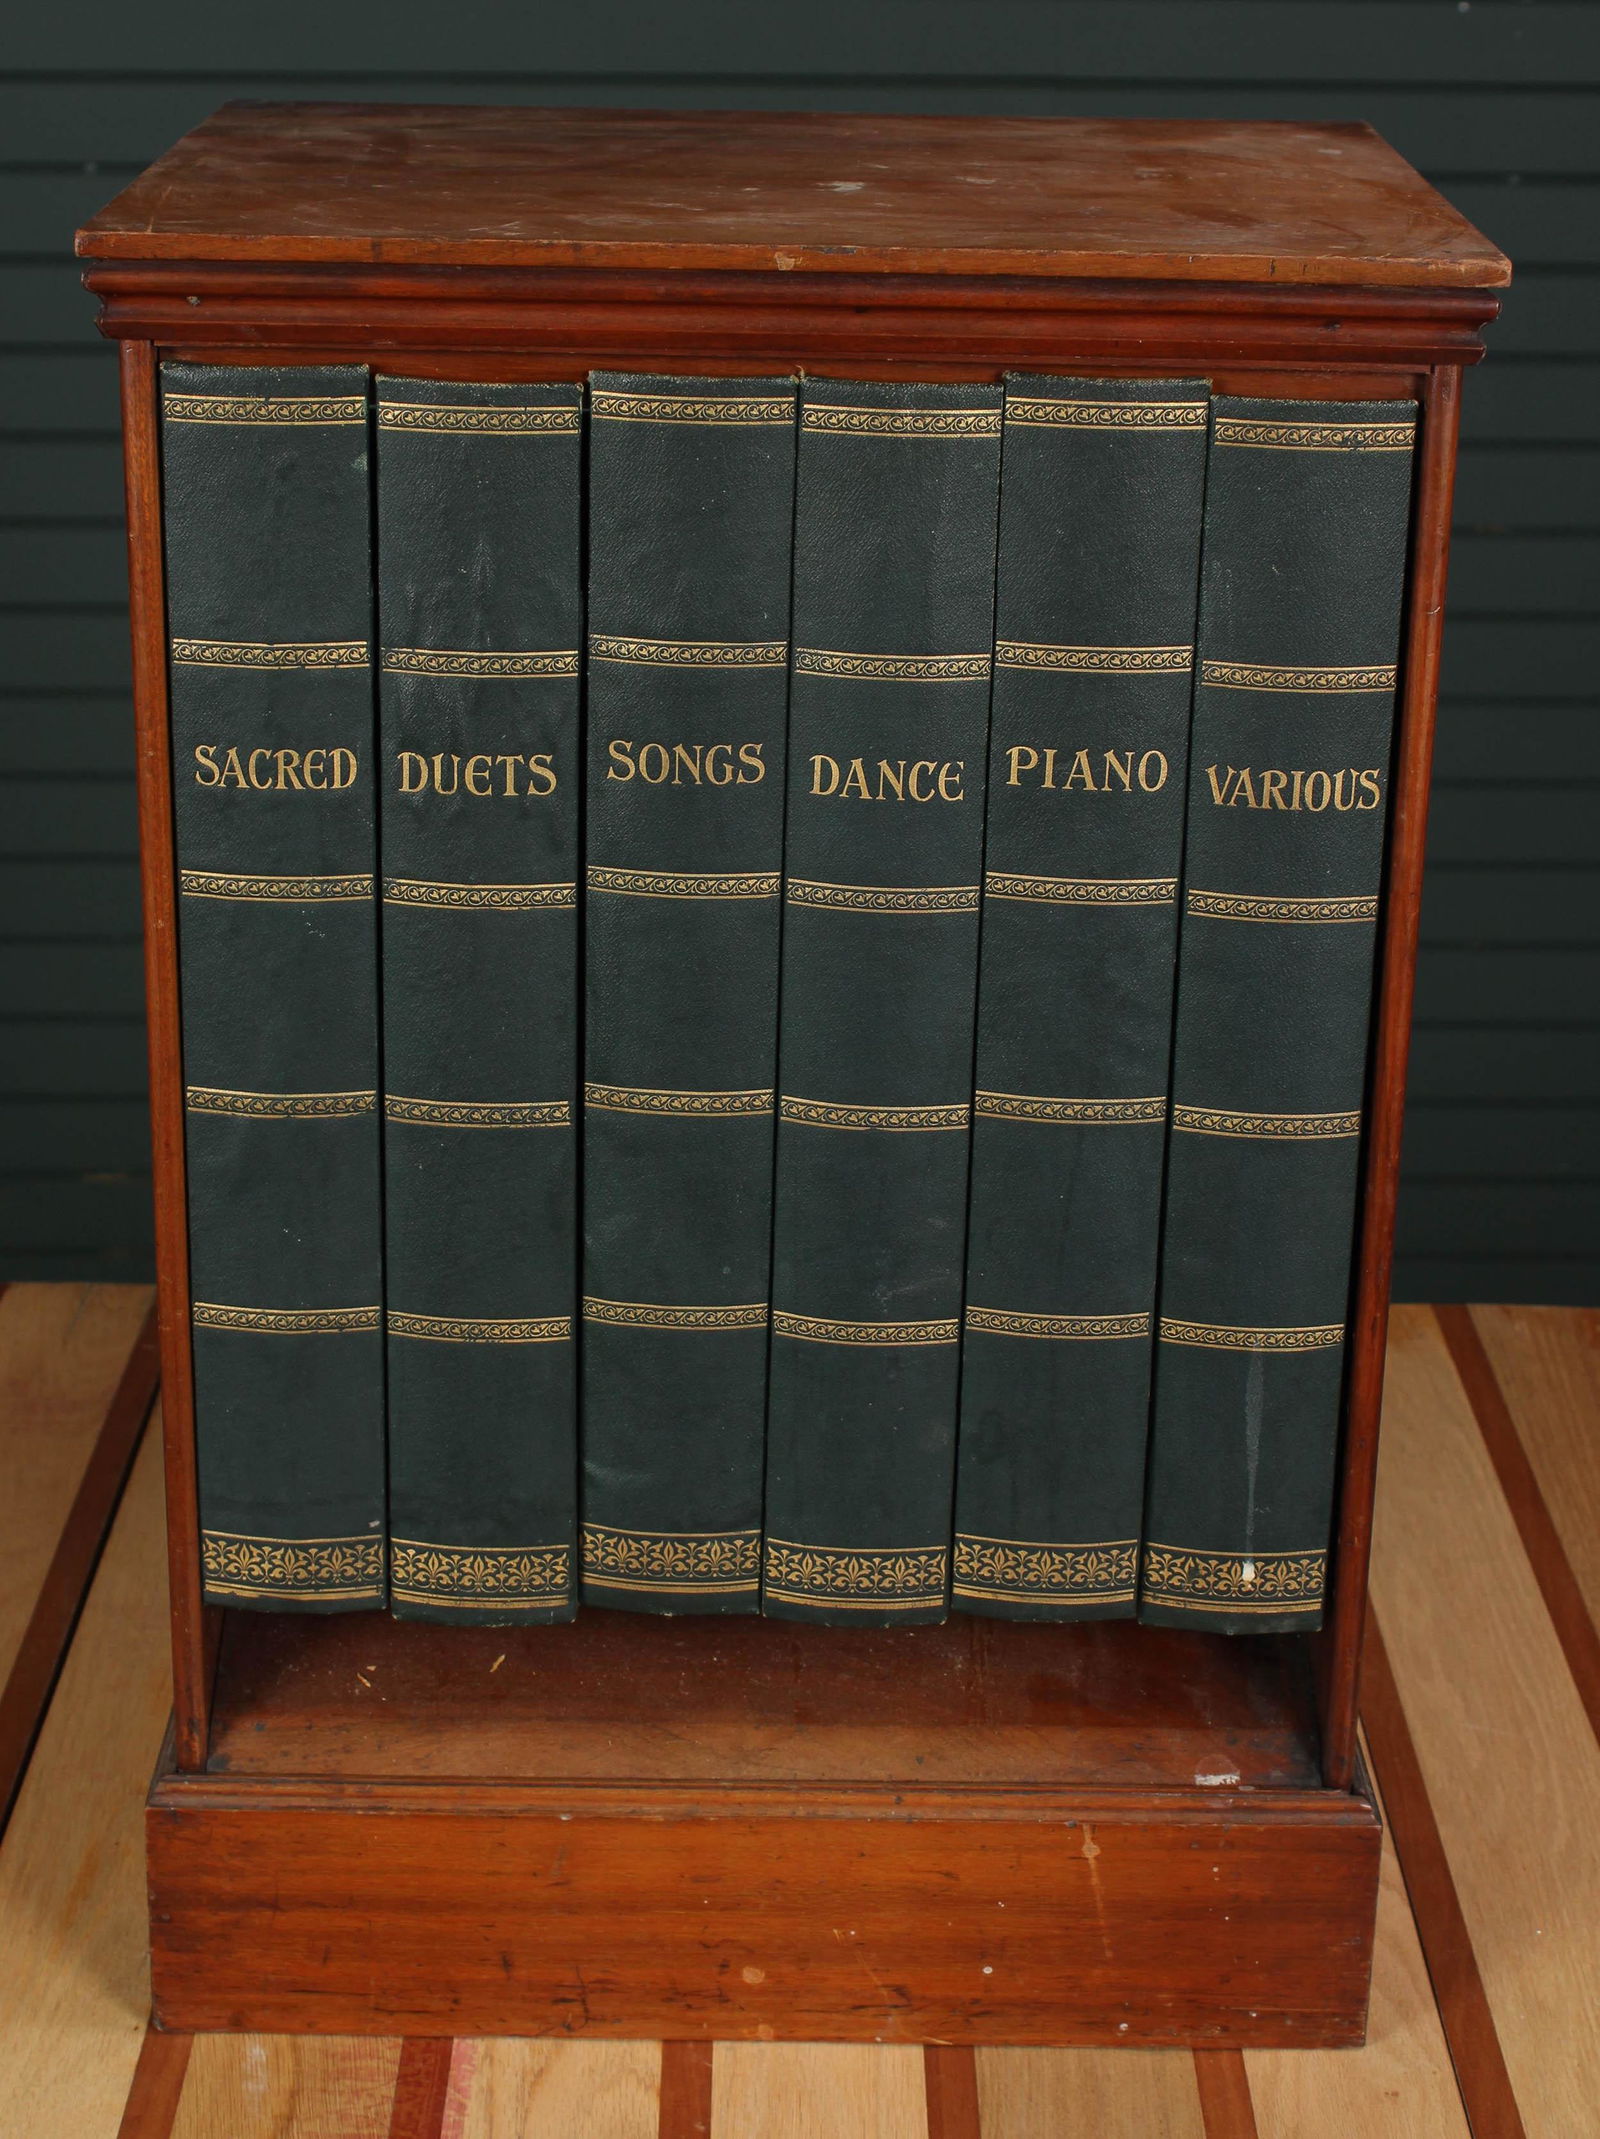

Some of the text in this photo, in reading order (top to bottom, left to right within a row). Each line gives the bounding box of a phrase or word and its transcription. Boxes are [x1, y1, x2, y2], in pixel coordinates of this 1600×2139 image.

[194, 744, 358, 790] SACRED
[397, 751, 558, 797] DUETS
[606, 740, 766, 786] SONGS
[809, 754, 964, 802] DANCE
[1005, 745, 1169, 792] PIANO
[1205, 764, 1381, 812] VARIOUS
